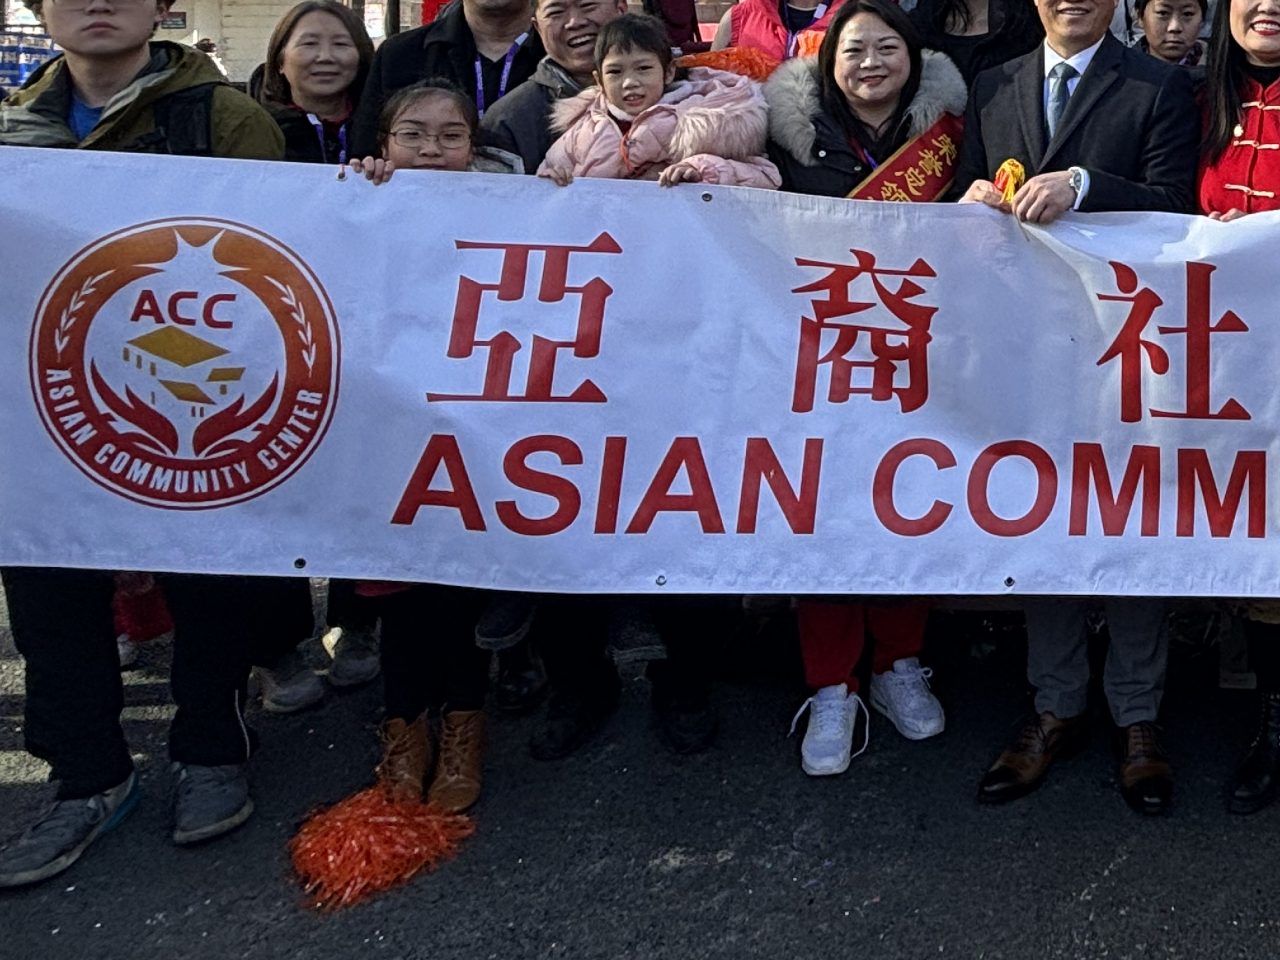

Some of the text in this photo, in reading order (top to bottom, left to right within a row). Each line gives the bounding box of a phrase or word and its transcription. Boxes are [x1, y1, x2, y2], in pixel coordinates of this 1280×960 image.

[867, 133, 958, 203] 荣誉总领
[130, 289, 238, 329] ACC
[46, 368, 323, 494] ASIAN COMMUNITY CENTER
[390, 434, 823, 536] ASIAN
